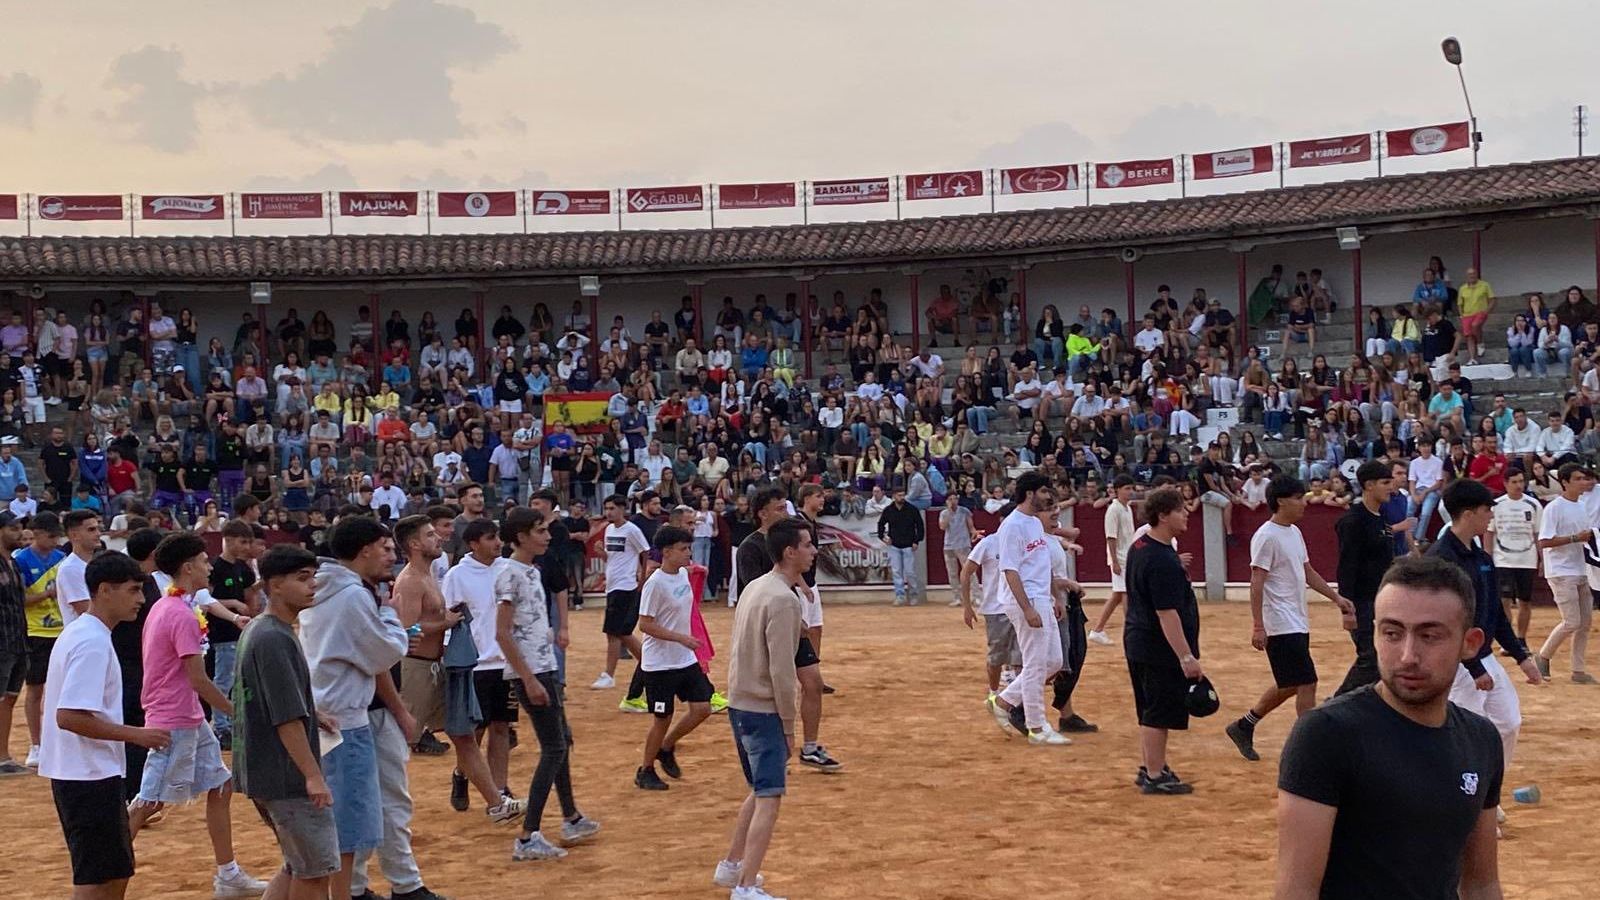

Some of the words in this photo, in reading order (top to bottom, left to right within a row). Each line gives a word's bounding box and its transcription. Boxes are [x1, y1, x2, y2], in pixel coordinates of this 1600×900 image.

[1127, 167, 1169, 179] BEHER
[649, 193, 701, 205] GARBLA
[349, 199, 408, 212] MAJUMA
